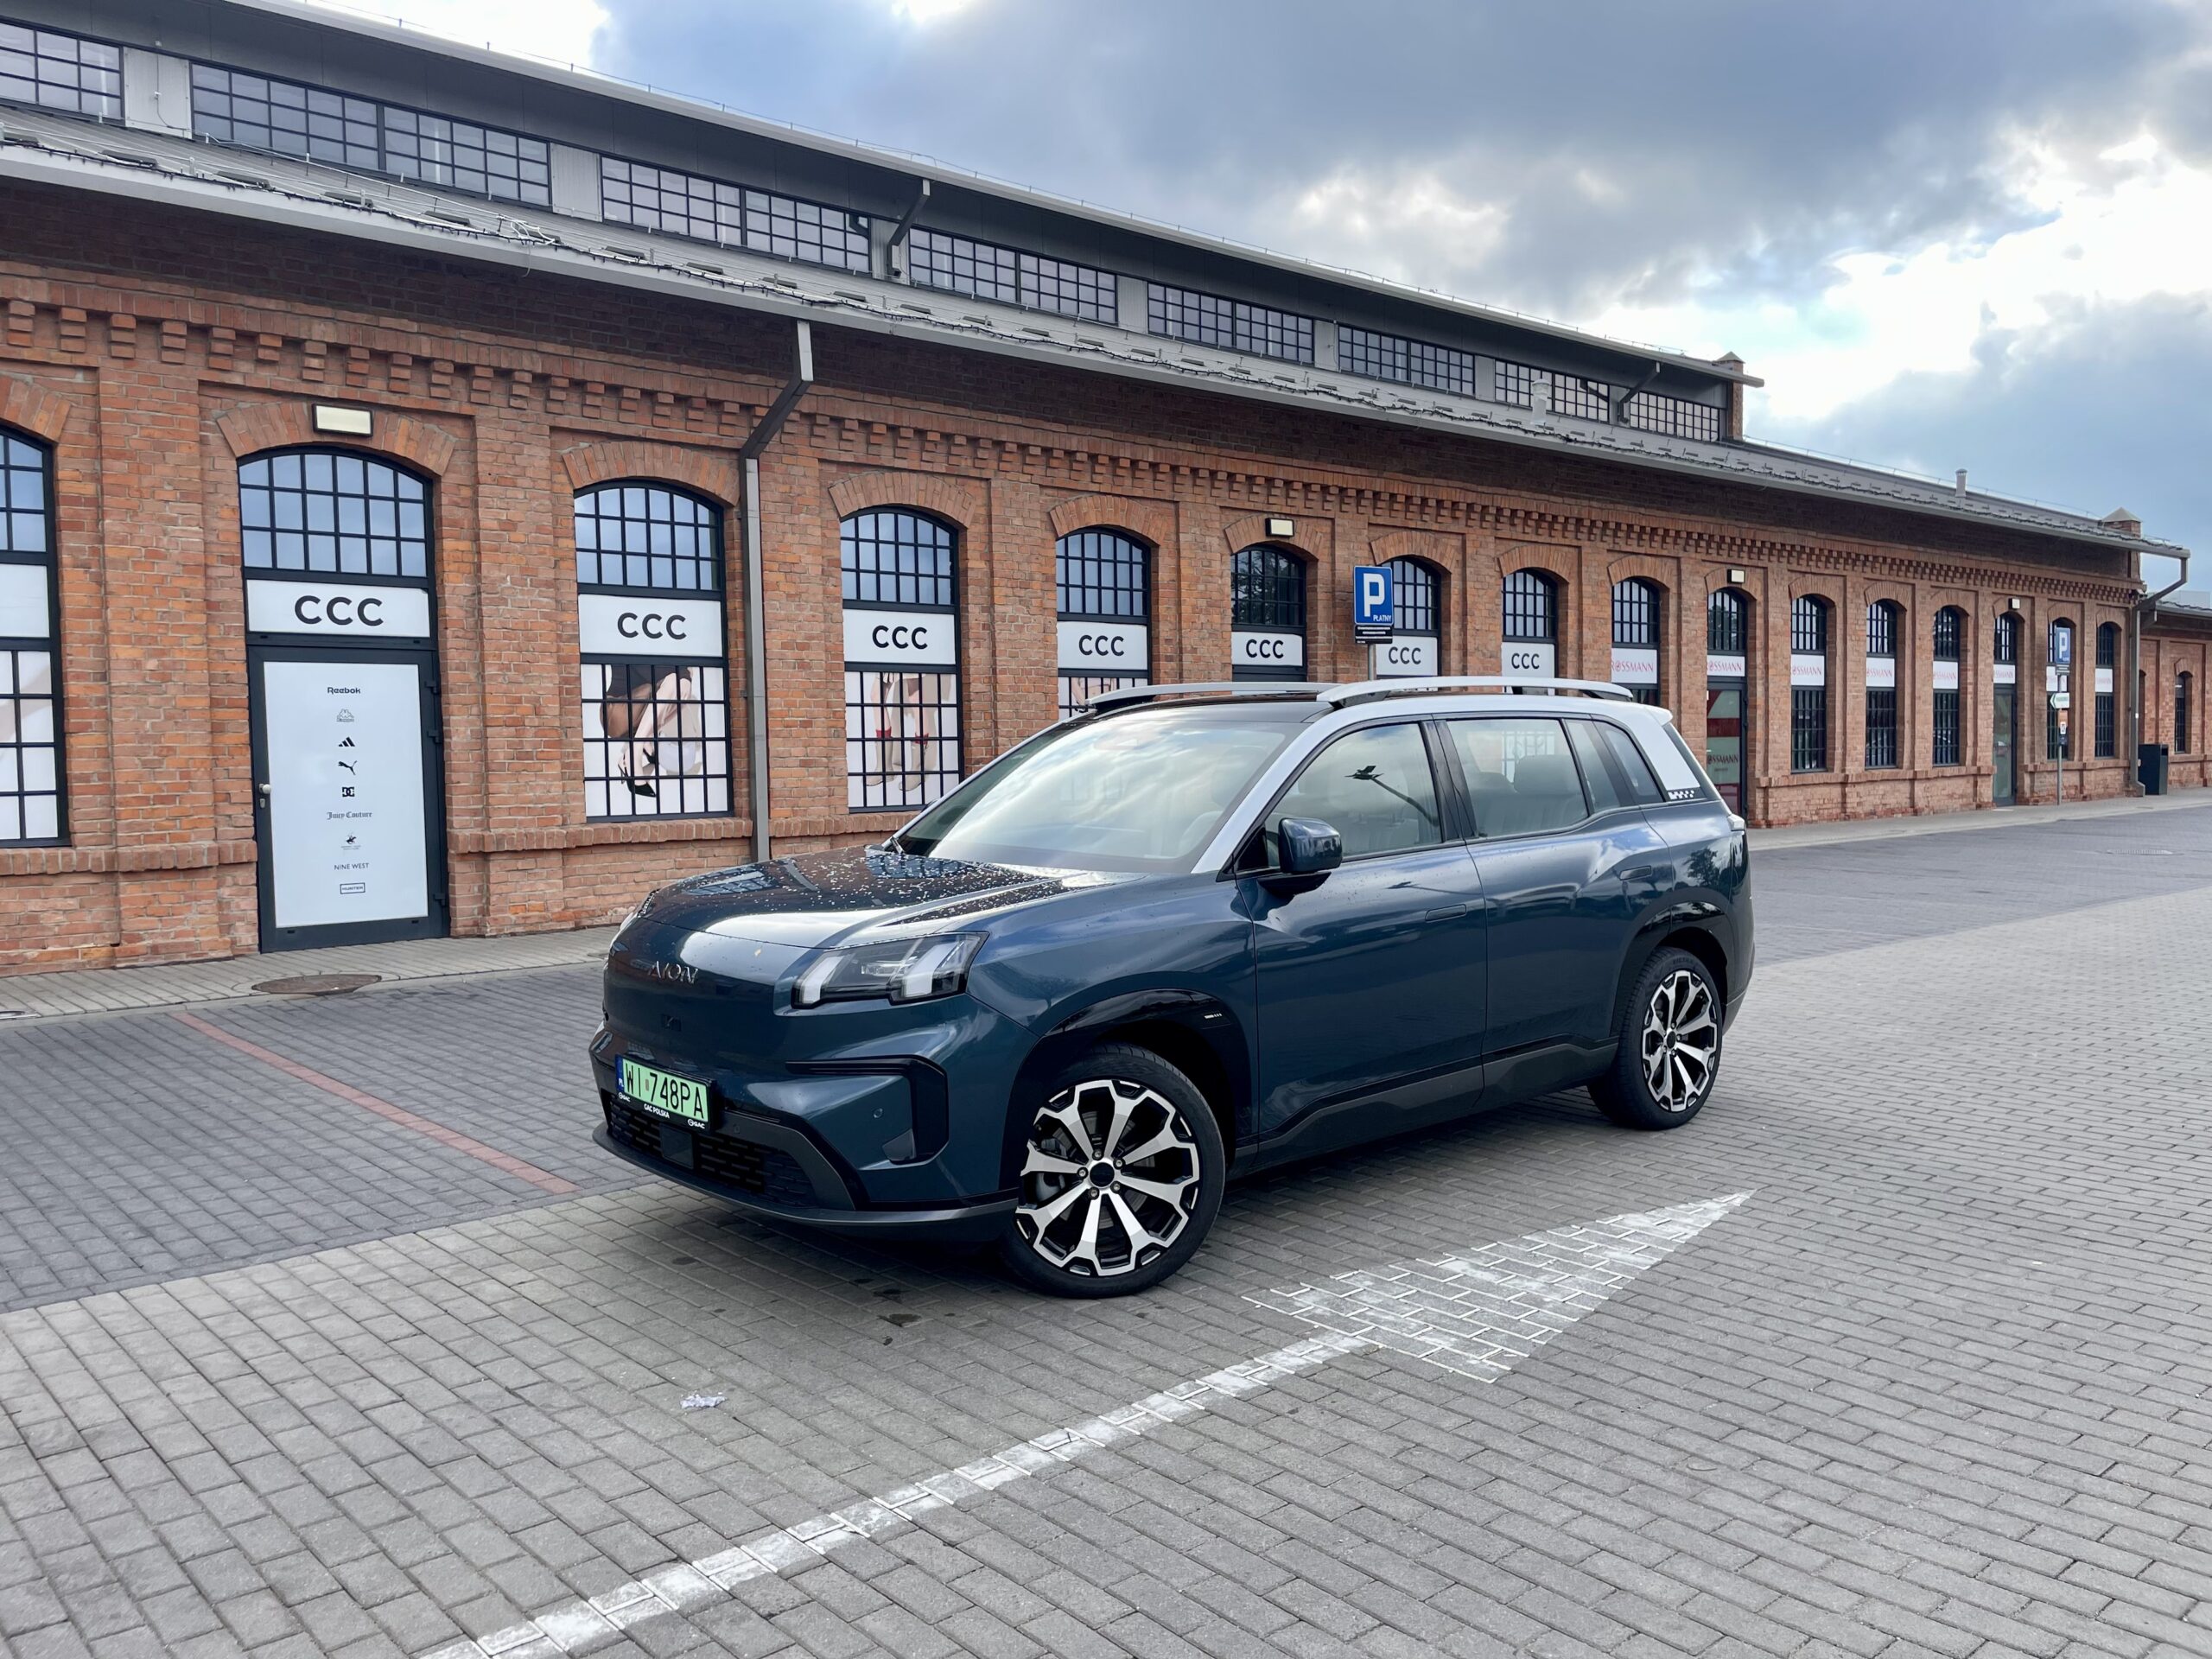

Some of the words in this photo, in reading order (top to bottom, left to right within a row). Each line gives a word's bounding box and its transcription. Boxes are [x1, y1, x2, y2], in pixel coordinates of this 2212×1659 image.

[1363, 573, 1384, 617] P
[295, 594, 384, 626] CCC
[617, 612, 687, 639] CCC
[872, 625, 928, 650] CCC
[1078, 634, 1124, 656] CCC
[2059, 632, 2068, 658] P
[1245, 639, 1284, 659] CCC
[1388, 646, 1421, 665] CCC
[1510, 652, 1540, 670] CCC
[1708, 660, 1742, 671] OSSMANN
[327, 686, 361, 695] Reebok
[626, 1063, 641, 1097] WI
[650, 1072, 704, 1119] 748PA
[652, 1107, 671, 1119] POLSKA
